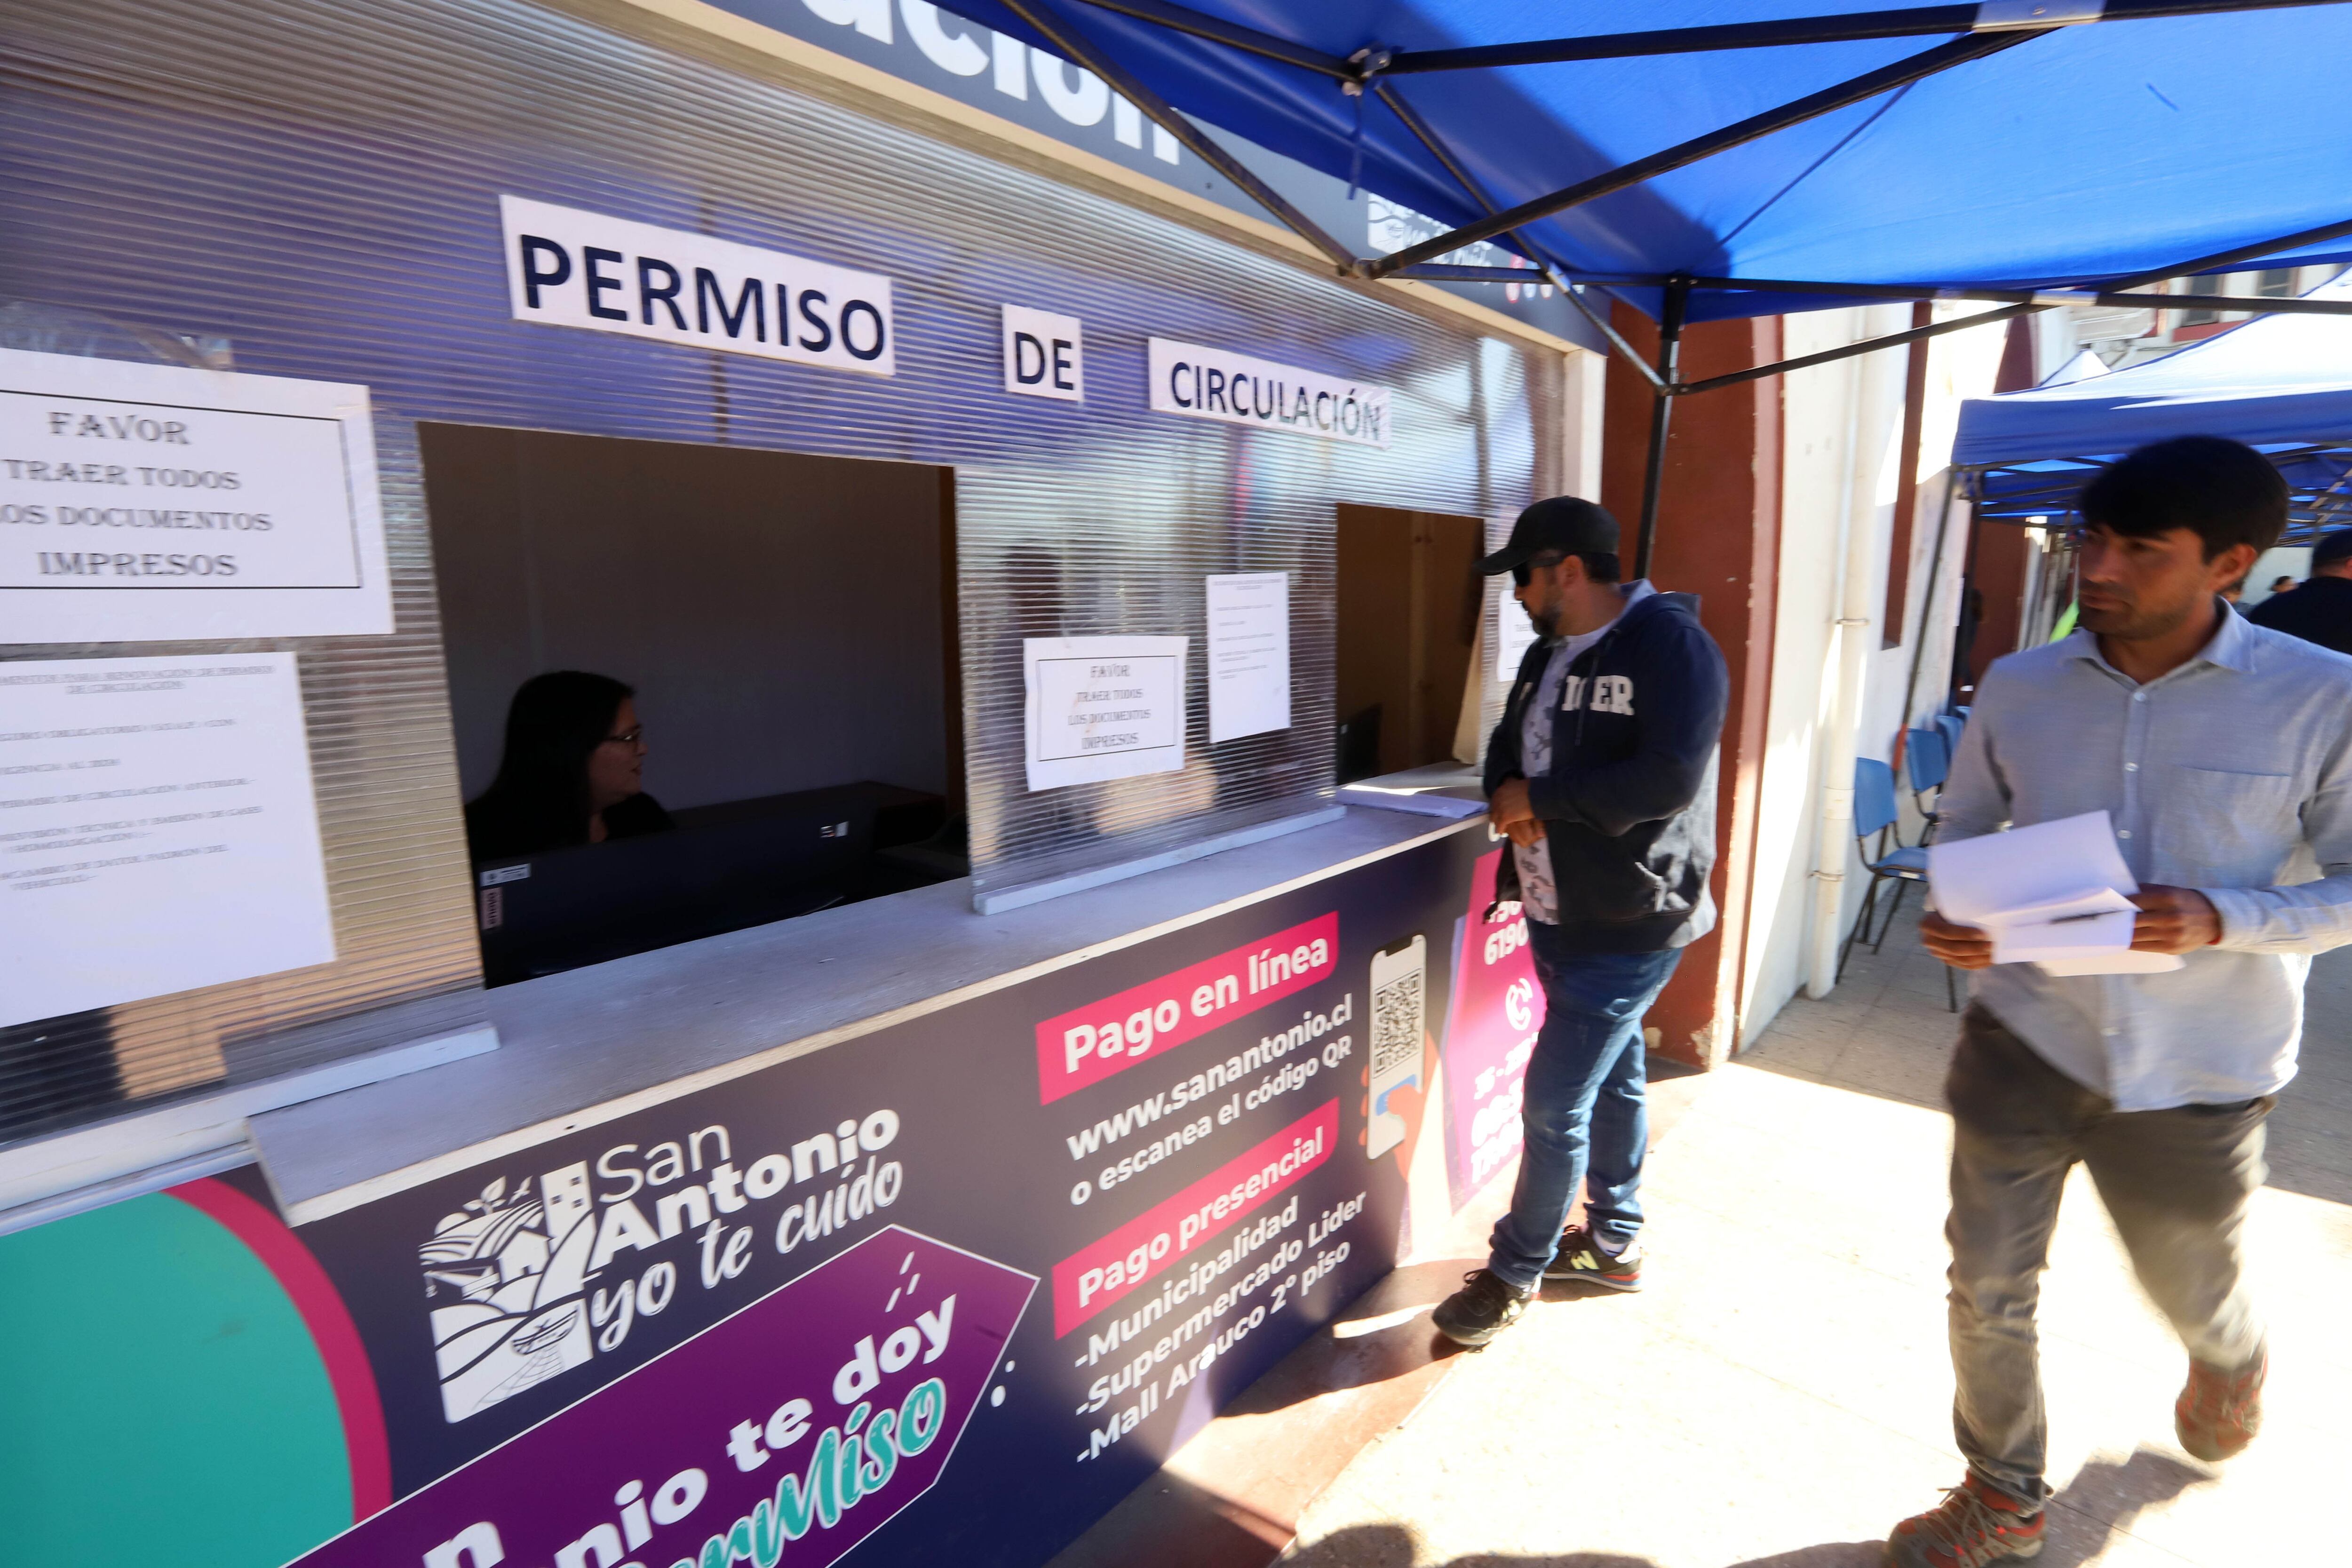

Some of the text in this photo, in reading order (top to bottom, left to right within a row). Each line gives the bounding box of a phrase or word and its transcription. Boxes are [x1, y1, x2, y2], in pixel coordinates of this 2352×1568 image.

[520, 234, 1380, 439] PERMISO DE CIRCULACIÓN
[0, 459, 241, 491] TRAER TODOS
[46, 412, 191, 445] FAVOR
[0, 504, 273, 531] OS DOCUMENTOS
[36, 552, 238, 577] IMPRESOS
[1064, 938, 1328, 1074] Pago en línea
[1066, 993, 1353, 1161] www.sanantonio.cl
[587, 1109, 900, 1272] Antonio
[596, 1125, 731, 1202] San
[1070, 1035, 1352, 1205] o escanea el código QR
[591, 1260, 676, 1353] yo
[697, 1219, 753, 1289] te
[1075, 1195, 1299, 1368] -Municipalidad
[1078, 1126, 1324, 1308] Pago presencial
[726, 1398, 813, 1472] te
[832, 1294, 957, 1405] doy
[1076, 1191, 1367, 1416] -Supermercado Lider
[1077, 1382, 1159, 1463] -Mall
[1166, 1304, 1265, 1399] Arauco
[1301, 1242, 1351, 1297] piso
